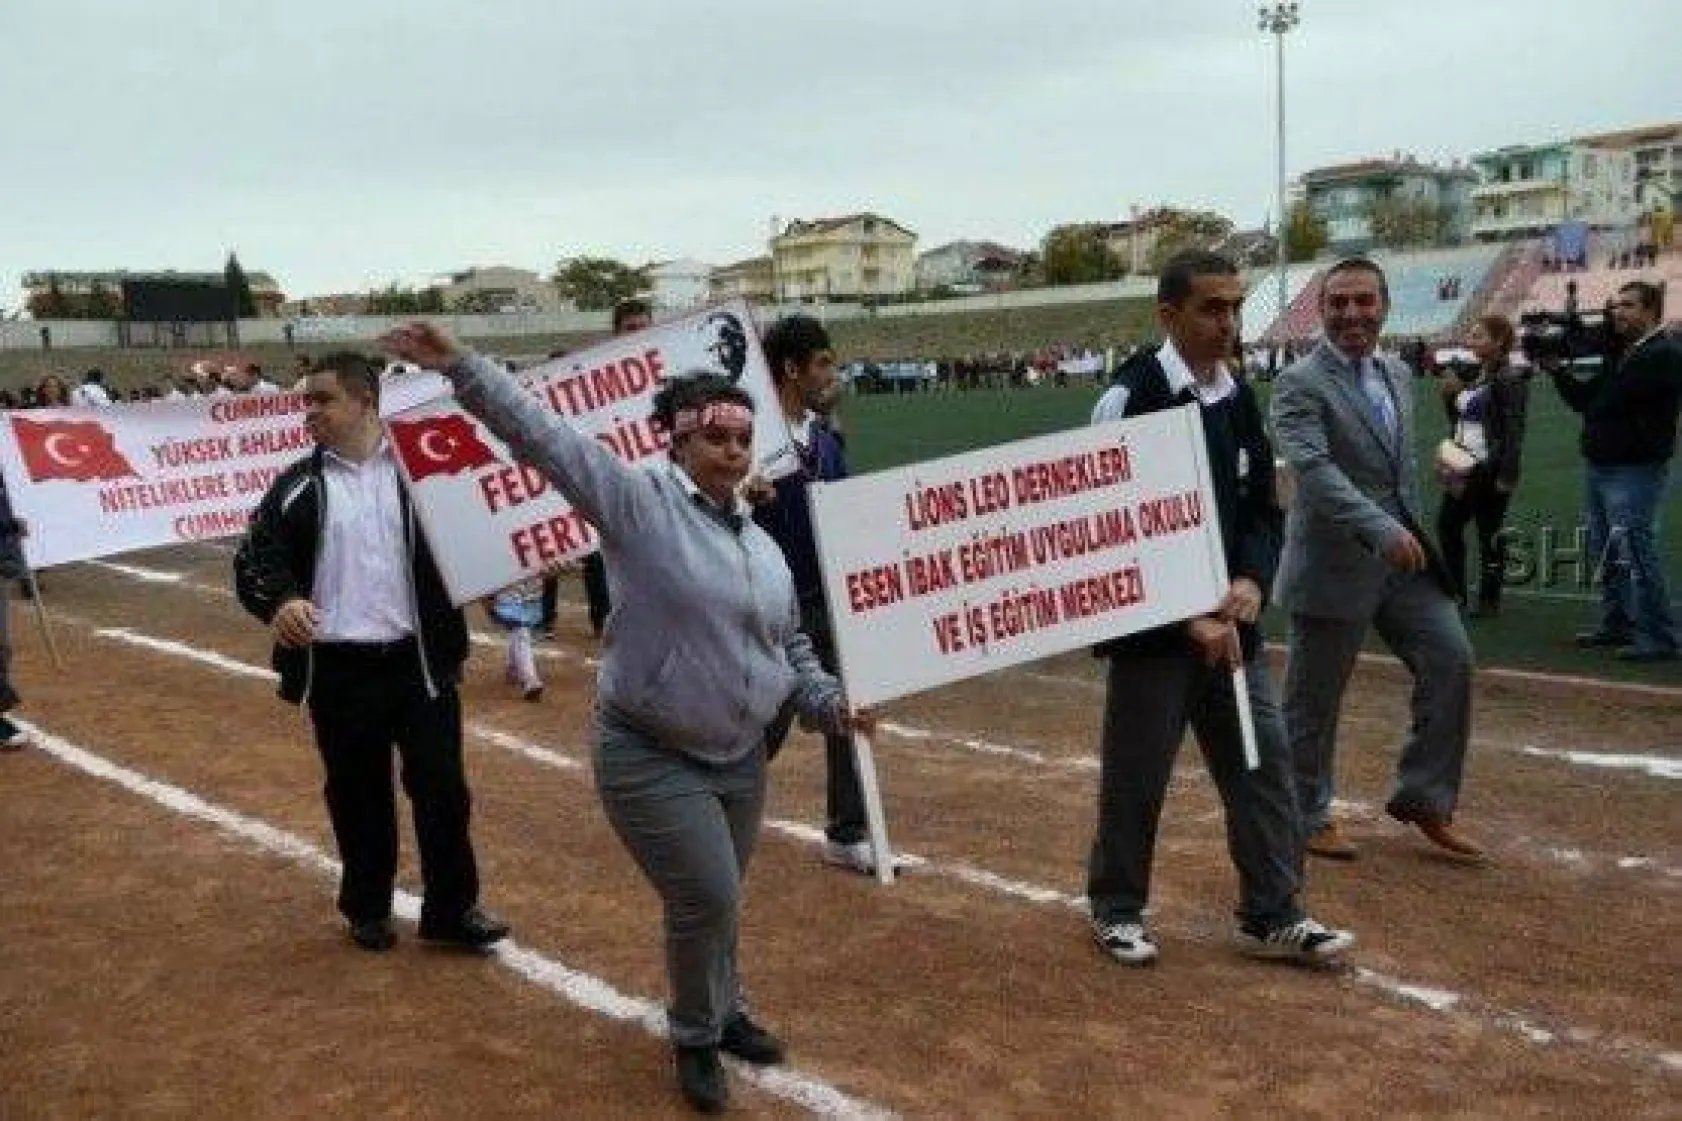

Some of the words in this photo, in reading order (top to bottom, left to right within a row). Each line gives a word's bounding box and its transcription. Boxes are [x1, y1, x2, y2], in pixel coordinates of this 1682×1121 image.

[520, 348, 665, 417] İTİMDE
[151, 435, 232, 469] YÜKSEK
[970, 473, 1010, 515] LEO
[1012, 436, 1132, 503] DERNEKLERİ
[100, 479, 229, 511] NİTELİKLERE
[479, 464, 548, 514] FED
[905, 549, 958, 597] İBAK
[959, 527, 1029, 582] EĞİTİM
[1031, 507, 1136, 564] UYGULAMA
[1138, 490, 1202, 537] OKULU
[933, 616, 965, 654] VE
[964, 602, 988, 658] İŞ
[989, 586, 1058, 640] EĞİTİM
[1060, 557, 1145, 620] MERKEZİ
